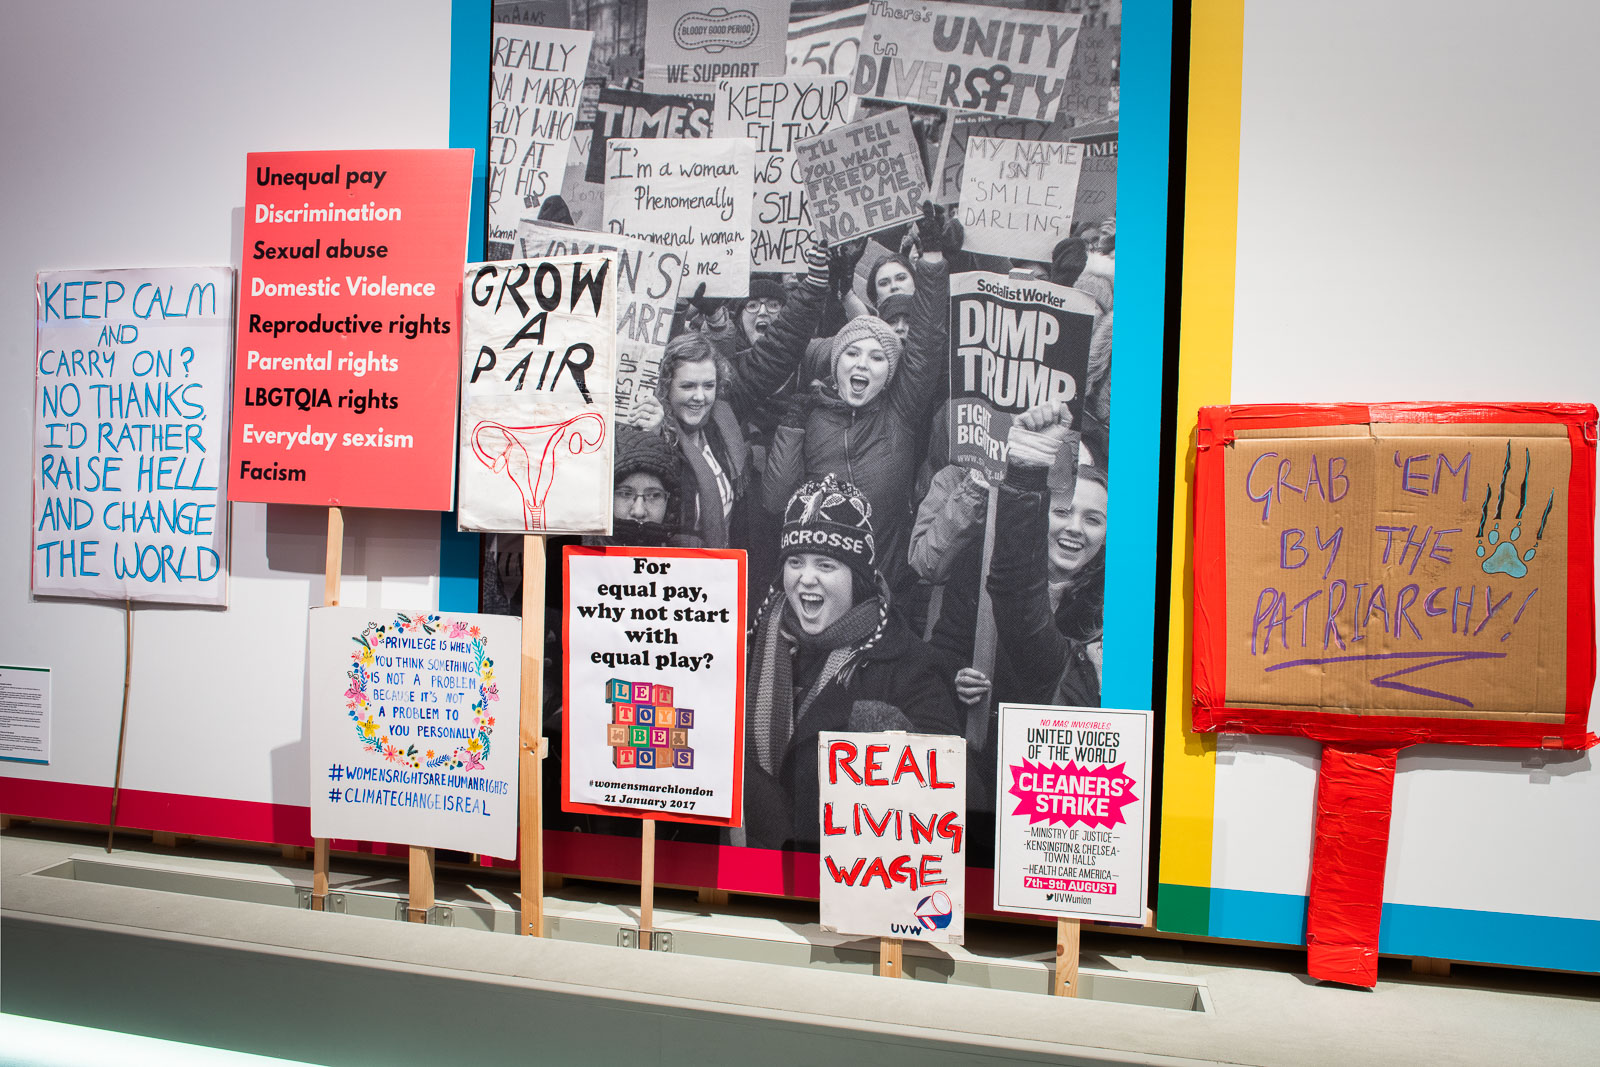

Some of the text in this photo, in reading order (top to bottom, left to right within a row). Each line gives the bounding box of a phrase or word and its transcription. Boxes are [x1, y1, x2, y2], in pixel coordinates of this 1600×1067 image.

[682, 24, 751, 35] BLOODY GOOD PERIOD
[870, 0, 1078, 68] There's UNITY
[494, 36, 576, 72] REALLY
[873, 34, 898, 56] in
[667, 62, 759, 84] WE SUPPORT
[521, 77, 584, 107] MARRY
[718, 80, 848, 124] "KEEP YOUR
[491, 102, 574, 140] GUY WHO
[846, 120, 900, 146] TELL
[522, 140, 554, 168] AT
[804, 160, 835, 183] YOU
[841, 140, 891, 168] WHAT
[970, 138, 1078, 165] MY NAME
[256, 164, 387, 190] Unequal pay
[515, 168, 548, 196] HIS
[660, 163, 672, 176] a
[680, 162, 739, 178] woman
[807, 152, 908, 200] FREEDOM
[1000, 160, 1050, 180] ISN'T
[254, 202, 402, 224] Discrimination
[634, 186, 734, 222] Phenomenally
[759, 190, 812, 226] SILK
[814, 185, 874, 218] IS TO
[864, 188, 924, 228] FEAR
[252, 238, 388, 260] Sexual abuse
[700, 230, 744, 246] woman
[251, 276, 436, 297] Domestic Violence
[471, 258, 614, 318] GROW
[977, 278, 1066, 308] Socialist Worker
[44, 281, 216, 322] KEEP CALM
[98, 324, 138, 346] AND
[249, 313, 450, 340] Reproductive rights
[502, 312, 548, 350] A
[960, 300, 1060, 362] DUMP
[40, 350, 115, 378] CARRY
[247, 350, 398, 377] Parental rights
[470, 342, 594, 404] PAIR
[619, 352, 638, 373] UP
[957, 347, 1076, 409] TRUMP
[42, 382, 207, 421] NO THANKS,
[244, 387, 398, 414] LBGTQIA rights
[958, 404, 992, 433] FIGHT
[43, 422, 206, 454] I'D RATHER
[242, 424, 414, 451] Everyday sexism
[42, 454, 218, 492] RAISE HELL
[240, 461, 306, 482] Facism
[1246, 450, 1472, 522] GRAB 'EM
[38, 497, 216, 536] AND CHANGE
[781, 530, 863, 554] LACROSSE
[1280, 524, 1463, 580] BY THE
[36, 540, 220, 584] THE WORLD
[633, 558, 671, 575] For
[598, 582, 708, 602] equal pay,
[578, 603, 730, 623] why not start
[1251, 578, 1538, 656] PATRIARCHY!
[386, 636, 472, 654] PRIVILEGE IS WHEN
[625, 628, 678, 644] with
[375, 655, 474, 674] YOU THINK SOMETHING
[590, 650, 714, 672] equal play?
[370, 672, 476, 690] IS NOT A PROBLEM
[617, 684, 670, 702] LET
[374, 690, 464, 704] BECAUSE IT'S NOT
[378, 706, 459, 720] A PROBLEM TO
[620, 707, 690, 724] TOYS
[1040, 719, 1112, 730] NO MAS INVISIBLES
[389, 725, 476, 739] YOU PERSONALLY
[634, 730, 664, 742] BE
[1027, 728, 1120, 748] UNITED VOICES
[622, 750, 689, 764] TOYS
[828, 740, 956, 790] REAL
[1028, 744, 1117, 764] OF THE WORLD
[328, 764, 509, 796] #WOMENSRIGHTSAREHUMANRIGHTS
[589, 780, 714, 797] #womensmarchlondon
[1018, 772, 1130, 797] CLEANERS'
[328, 788, 491, 816] #CLIMATECHANGEISREAL
[604, 794, 696, 810] 21 January 2017
[1036, 794, 1109, 817] STRIKE
[824, 802, 964, 854] LIVING
[1070, 830, 1079, 840] OF
[1044, 852, 1096, 866] TOWN HALLS
[1074, 844, 1080, 854] &
[824, 854, 948, 892] WAGE
[1058, 866, 1076, 878] CARE
[1026, 878, 1115, 894] 7th-9th AUGUST
[1054, 893, 1092, 905] UVWunion
[890, 922, 922, 936] UVW
